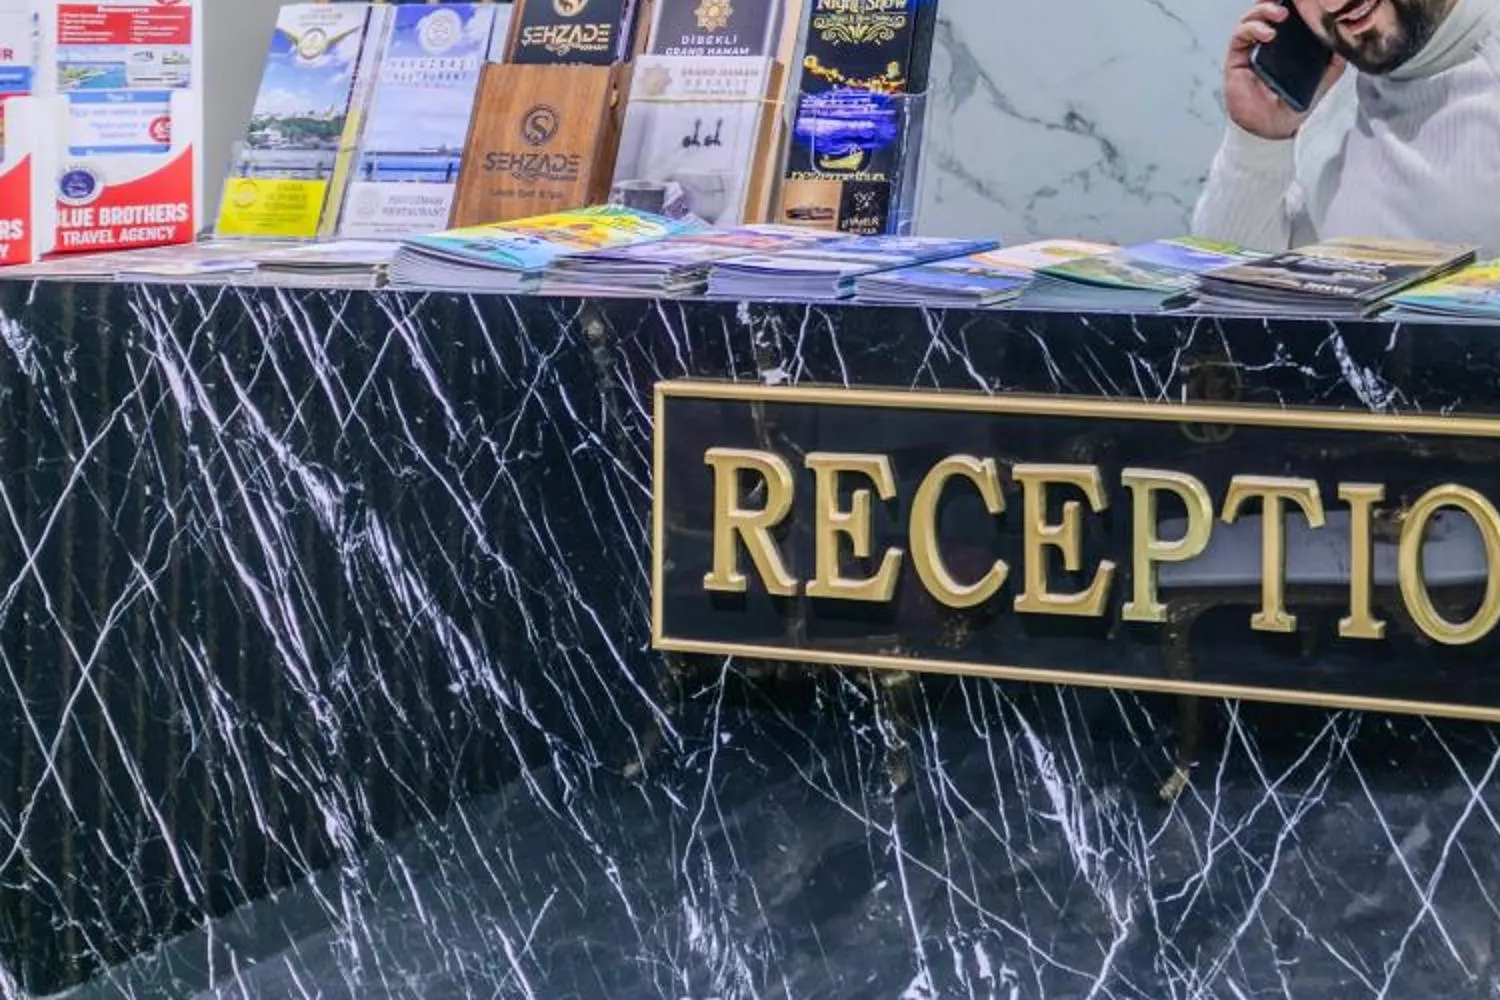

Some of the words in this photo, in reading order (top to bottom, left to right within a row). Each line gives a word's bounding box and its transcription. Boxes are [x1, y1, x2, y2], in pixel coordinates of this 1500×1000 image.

[707, 47, 751, 56] HAMAM
[56, 207, 95, 229] LUE
[98, 203, 189, 227] BROTHERS
[61, 229, 115, 246] TRAVEL
[119, 226, 177, 244] AGENCY
